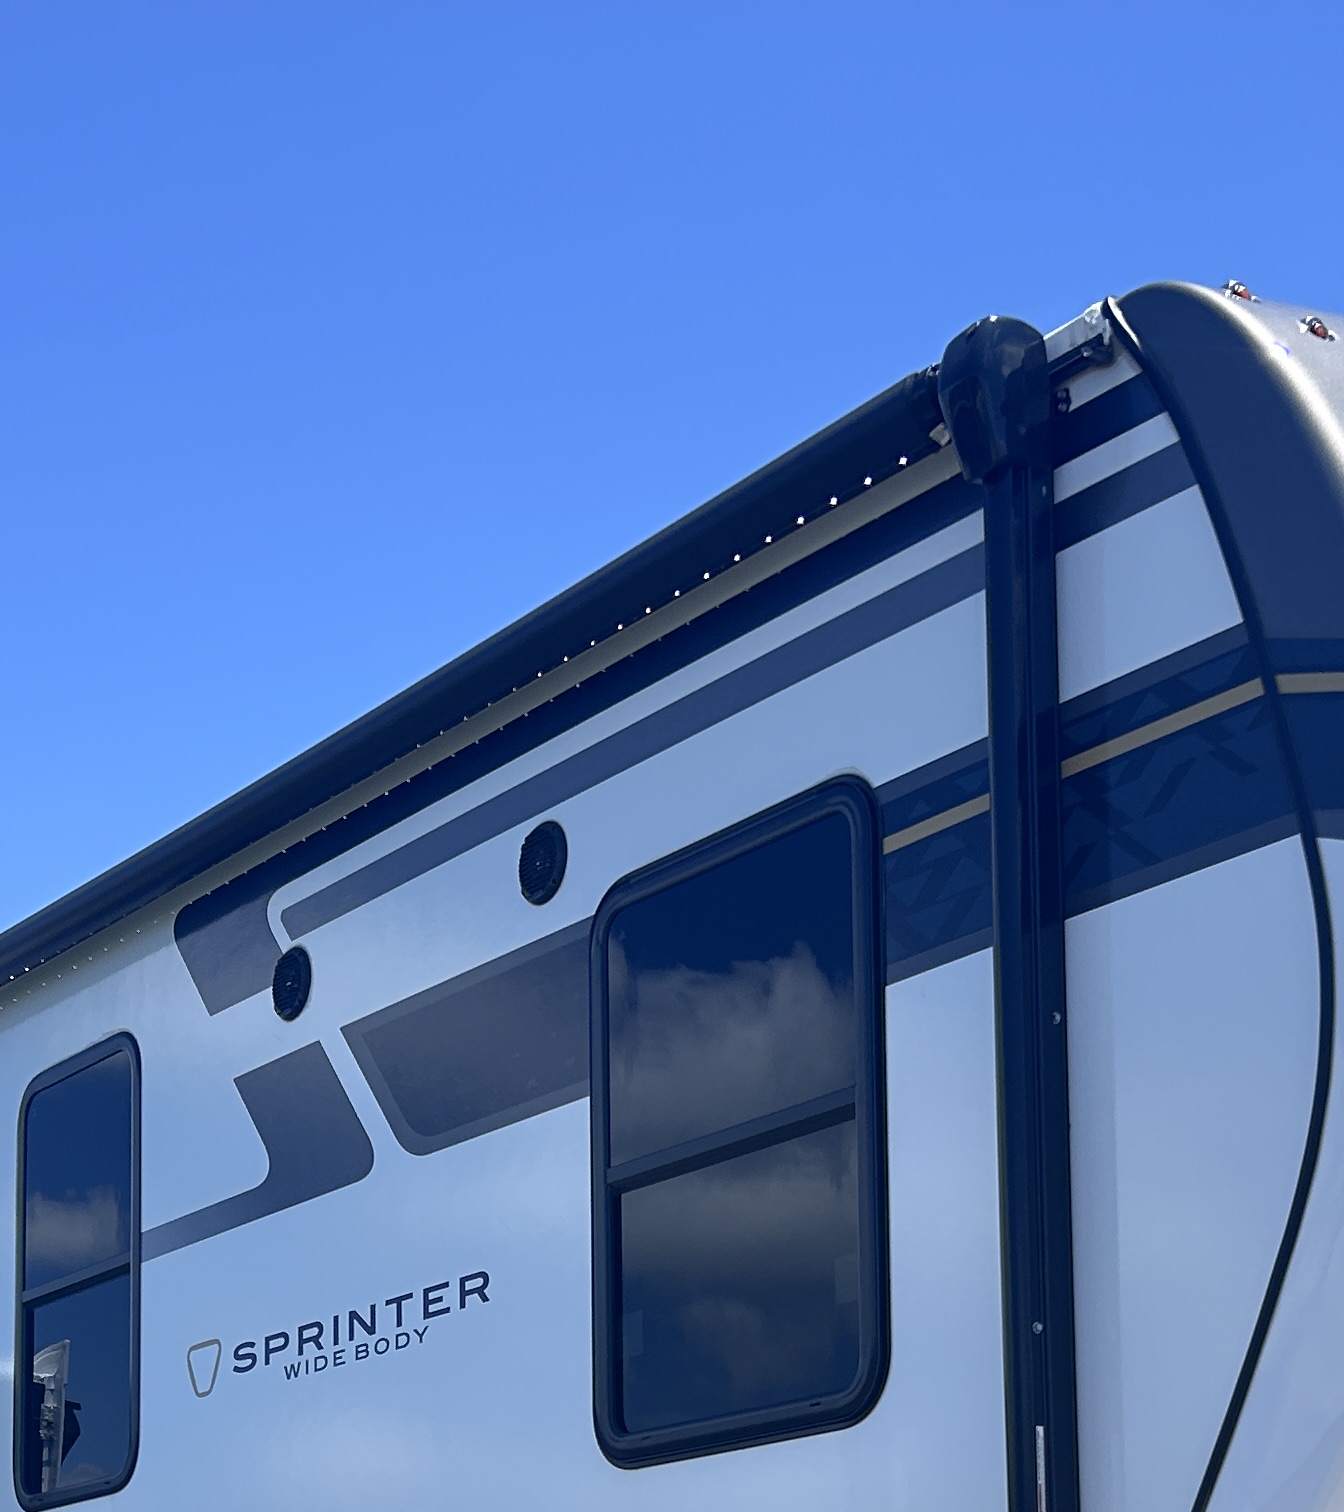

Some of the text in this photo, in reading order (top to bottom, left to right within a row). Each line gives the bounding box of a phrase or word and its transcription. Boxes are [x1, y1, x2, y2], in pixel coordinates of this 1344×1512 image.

[232, 1270, 491, 1373] SPRINTER
[284, 1325, 430, 1380] WIDE BODY
